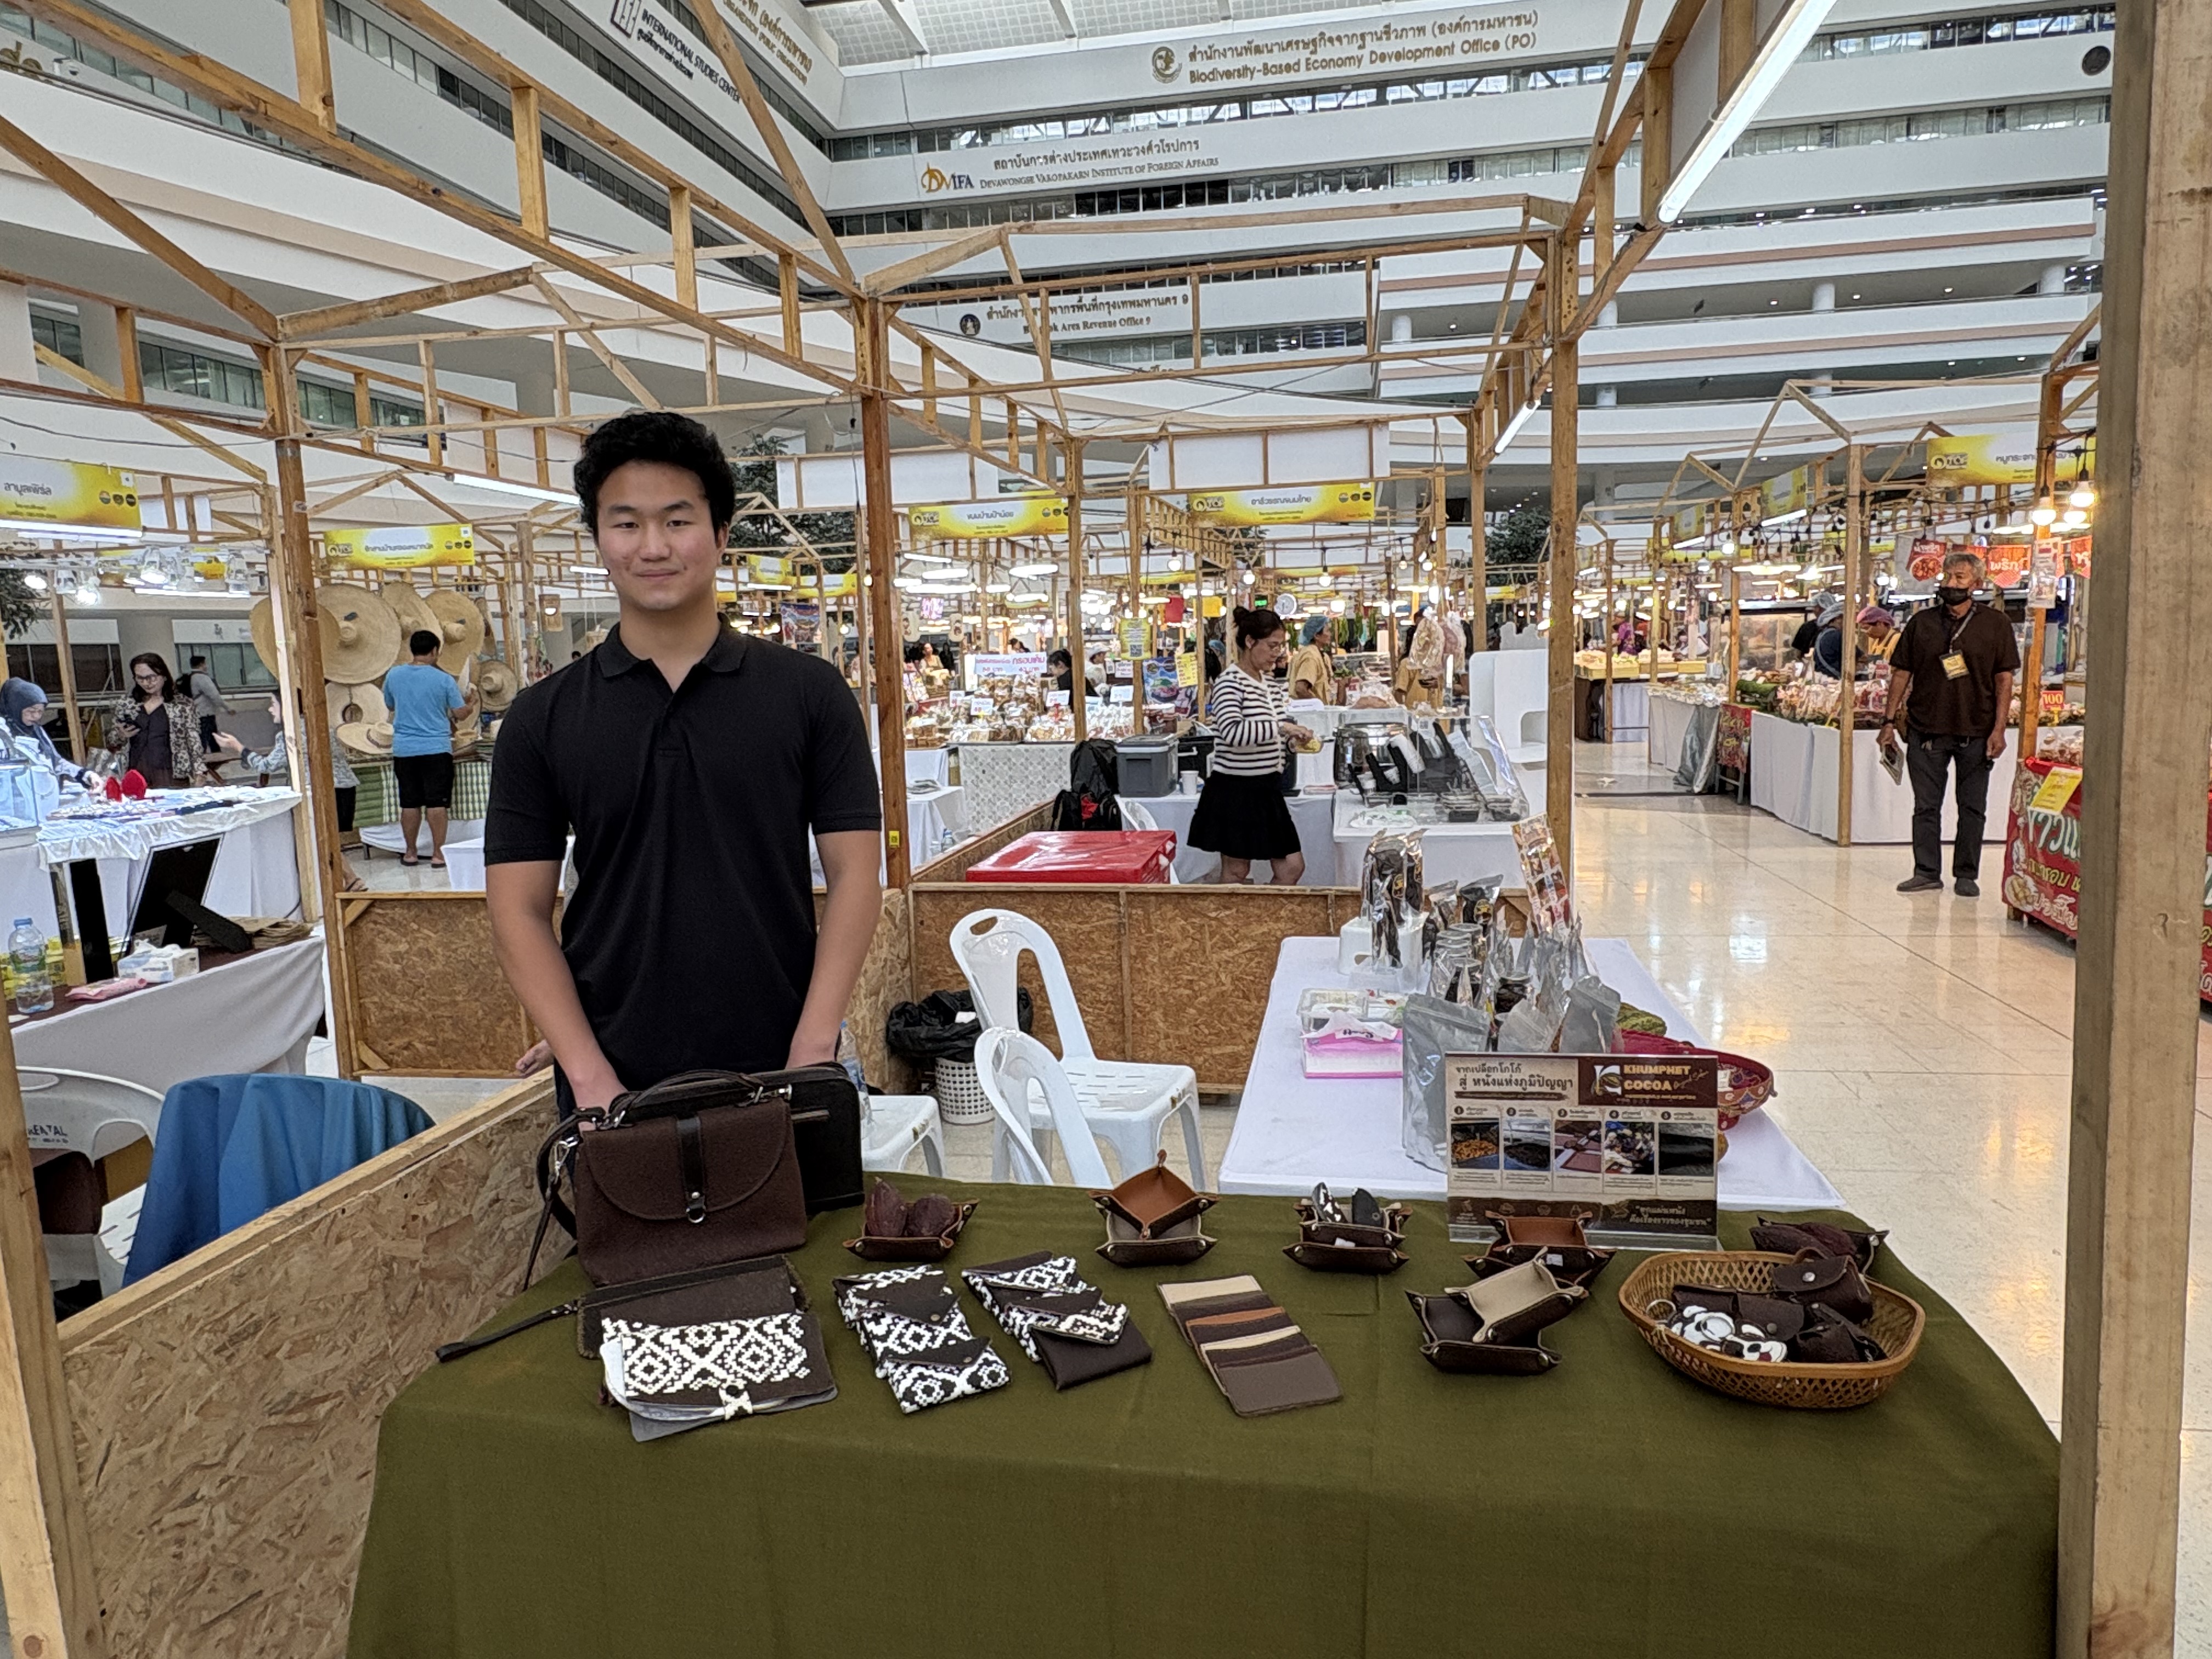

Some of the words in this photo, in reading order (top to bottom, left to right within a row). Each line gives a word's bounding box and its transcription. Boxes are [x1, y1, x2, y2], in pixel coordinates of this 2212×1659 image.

[1188, 22, 1426, 62] สำนักงานพัฒนาเศรษฐกิจจากฐานชีวภาพ
[1432, 9, 1538, 38] (องค์การมหาชน)
[642, 8, 694, 64] INTERNATIONAL
[694, 55, 720, 84] STUDIES
[1189, 59, 1301, 84] Biodiversity-Based
[1305, 54, 1364, 71] Economy
[1369, 41, 1455, 65] Development
[1460, 38, 1500, 54] Office
[1505, 32, 1537, 51] (PO)
[1061, 322, 1080, 331] Area
[1082, 320, 1117, 330] Revenue
[1119, 316, 1144, 327] Office
[2042, 693, 2063, 704] 100
[1624, 1064, 1691, 1075] KHUMPHET
[1472, 1074, 1574, 1091] หนังแห่งภูมิปัญญา
[1624, 1080, 1673, 1091] COCOA
